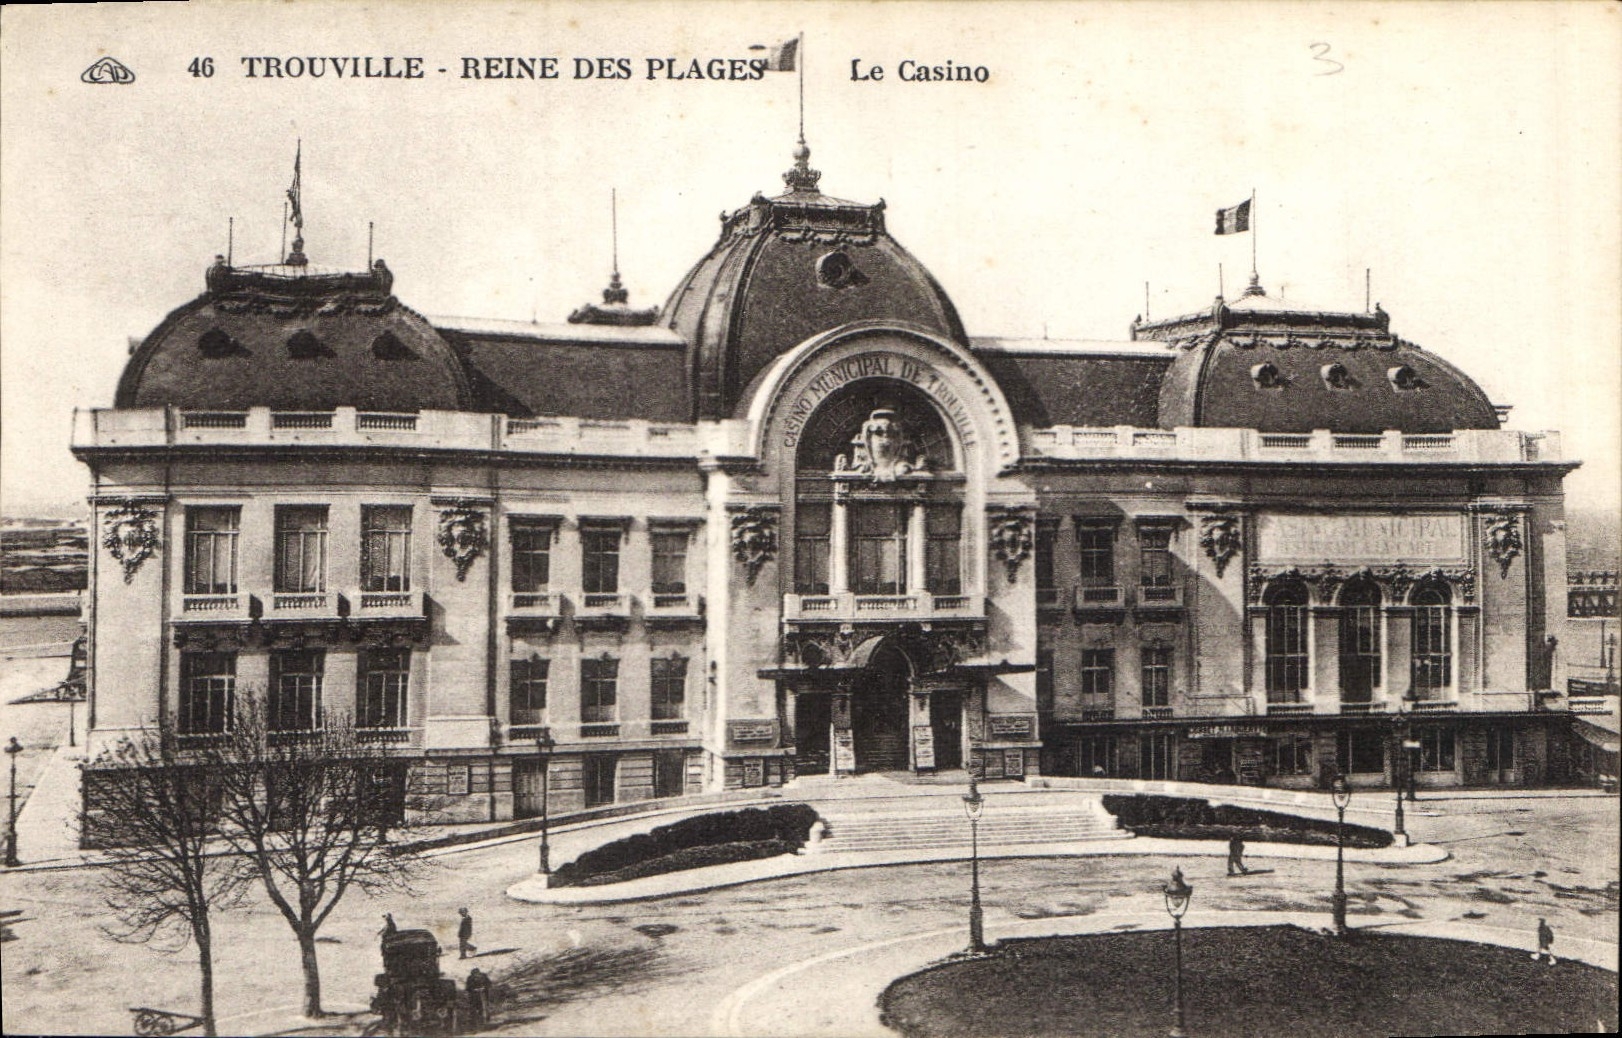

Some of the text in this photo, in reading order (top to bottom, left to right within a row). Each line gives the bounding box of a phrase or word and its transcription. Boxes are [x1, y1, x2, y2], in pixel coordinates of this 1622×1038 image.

[784, 398, 812, 448] CASINO
[810, 356, 895, 400] MUNICIPAL
[901, 361, 922, 384] DE
